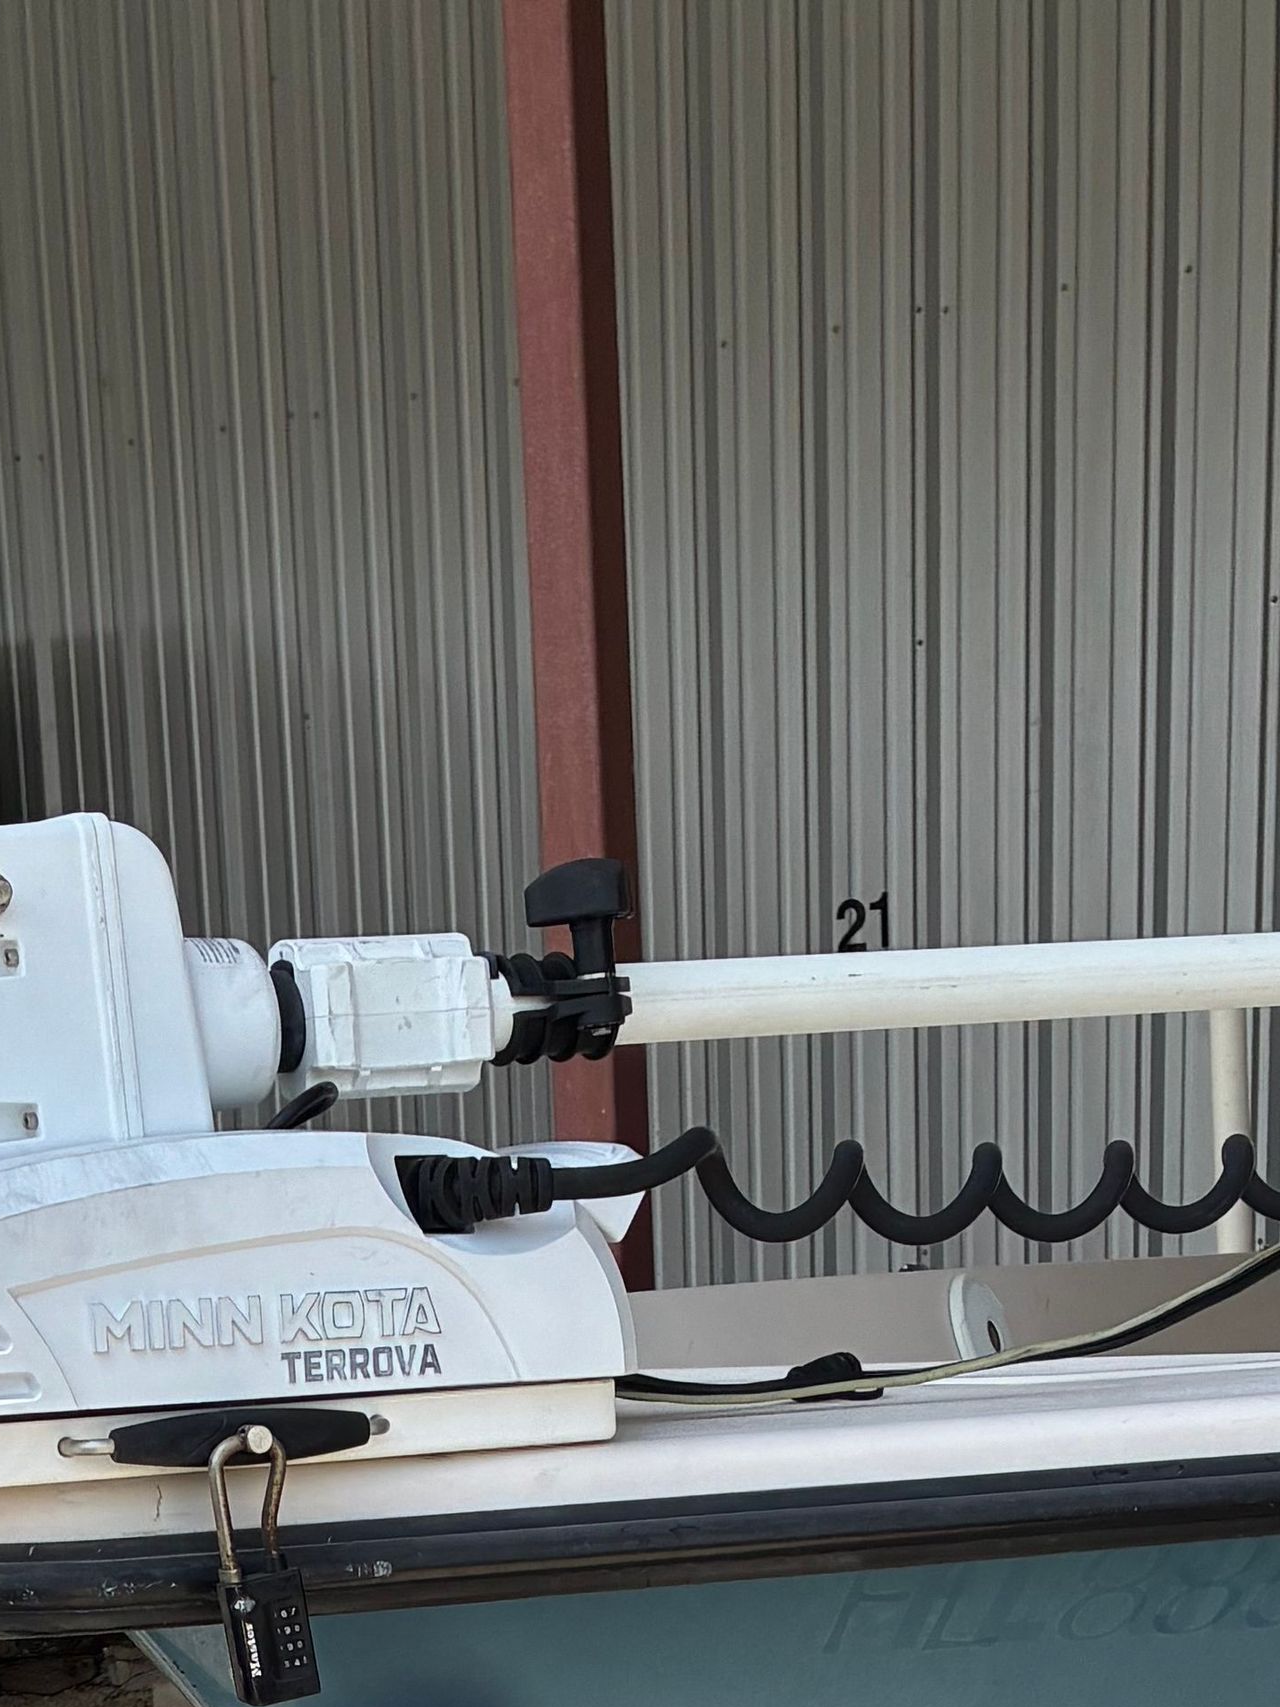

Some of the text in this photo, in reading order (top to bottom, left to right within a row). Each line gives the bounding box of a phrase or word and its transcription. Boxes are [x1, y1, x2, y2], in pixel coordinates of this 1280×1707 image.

[836, 890, 890, 953] 21
[89, 1286, 443, 1354] MINN KOTA
[280, 1343, 443, 1384] TERROVA
